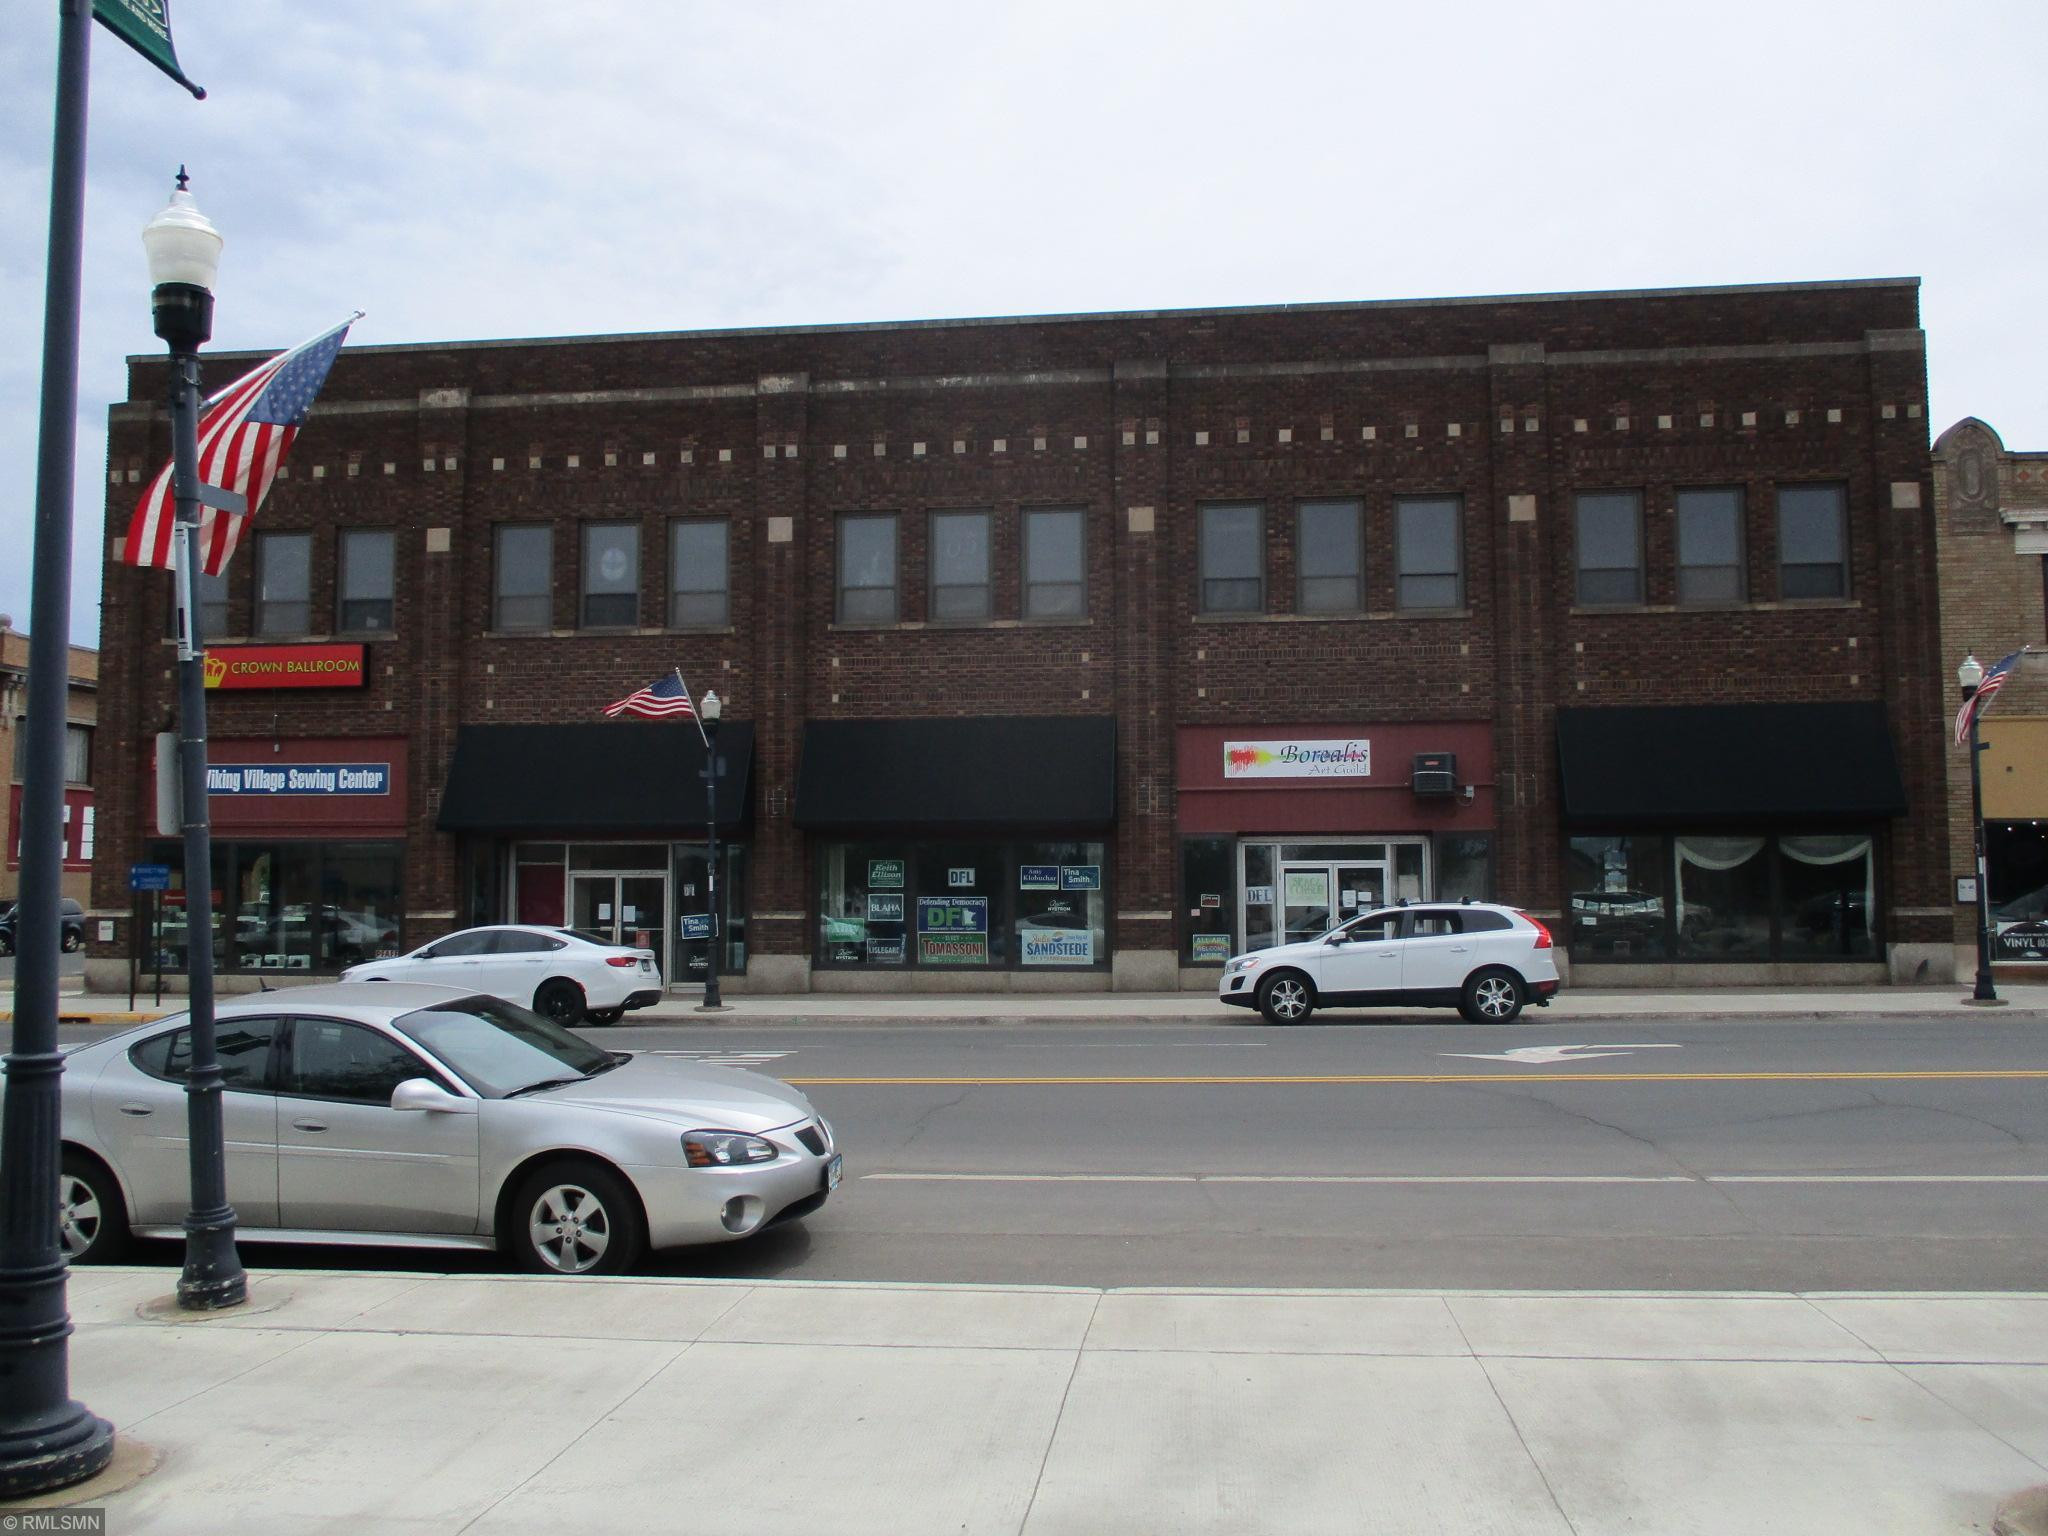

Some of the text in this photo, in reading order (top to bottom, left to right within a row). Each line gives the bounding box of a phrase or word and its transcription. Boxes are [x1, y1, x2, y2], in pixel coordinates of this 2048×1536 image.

[231, 660, 360, 674] CROWN BALLROOM
[1281, 741, 1368, 763] Borealis
[1308, 764, 1367, 775] Art Guild
[244, 769, 286, 792] Village
[289, 769, 335, 792] Sewing
[338, 768, 383, 789] Center
[951, 871, 973, 884] DFL
[1064, 868, 1079, 876] Tina
[1248, 890, 1272, 901] DFL
[920, 899, 985, 907] Defending Democracy
[688, 924, 709, 932] Smith
[922, 938, 983, 955] TOMASSONI
[2004, 938, 2036, 948] VINYL
[1027, 943, 1088, 955] SANDSTEDE
